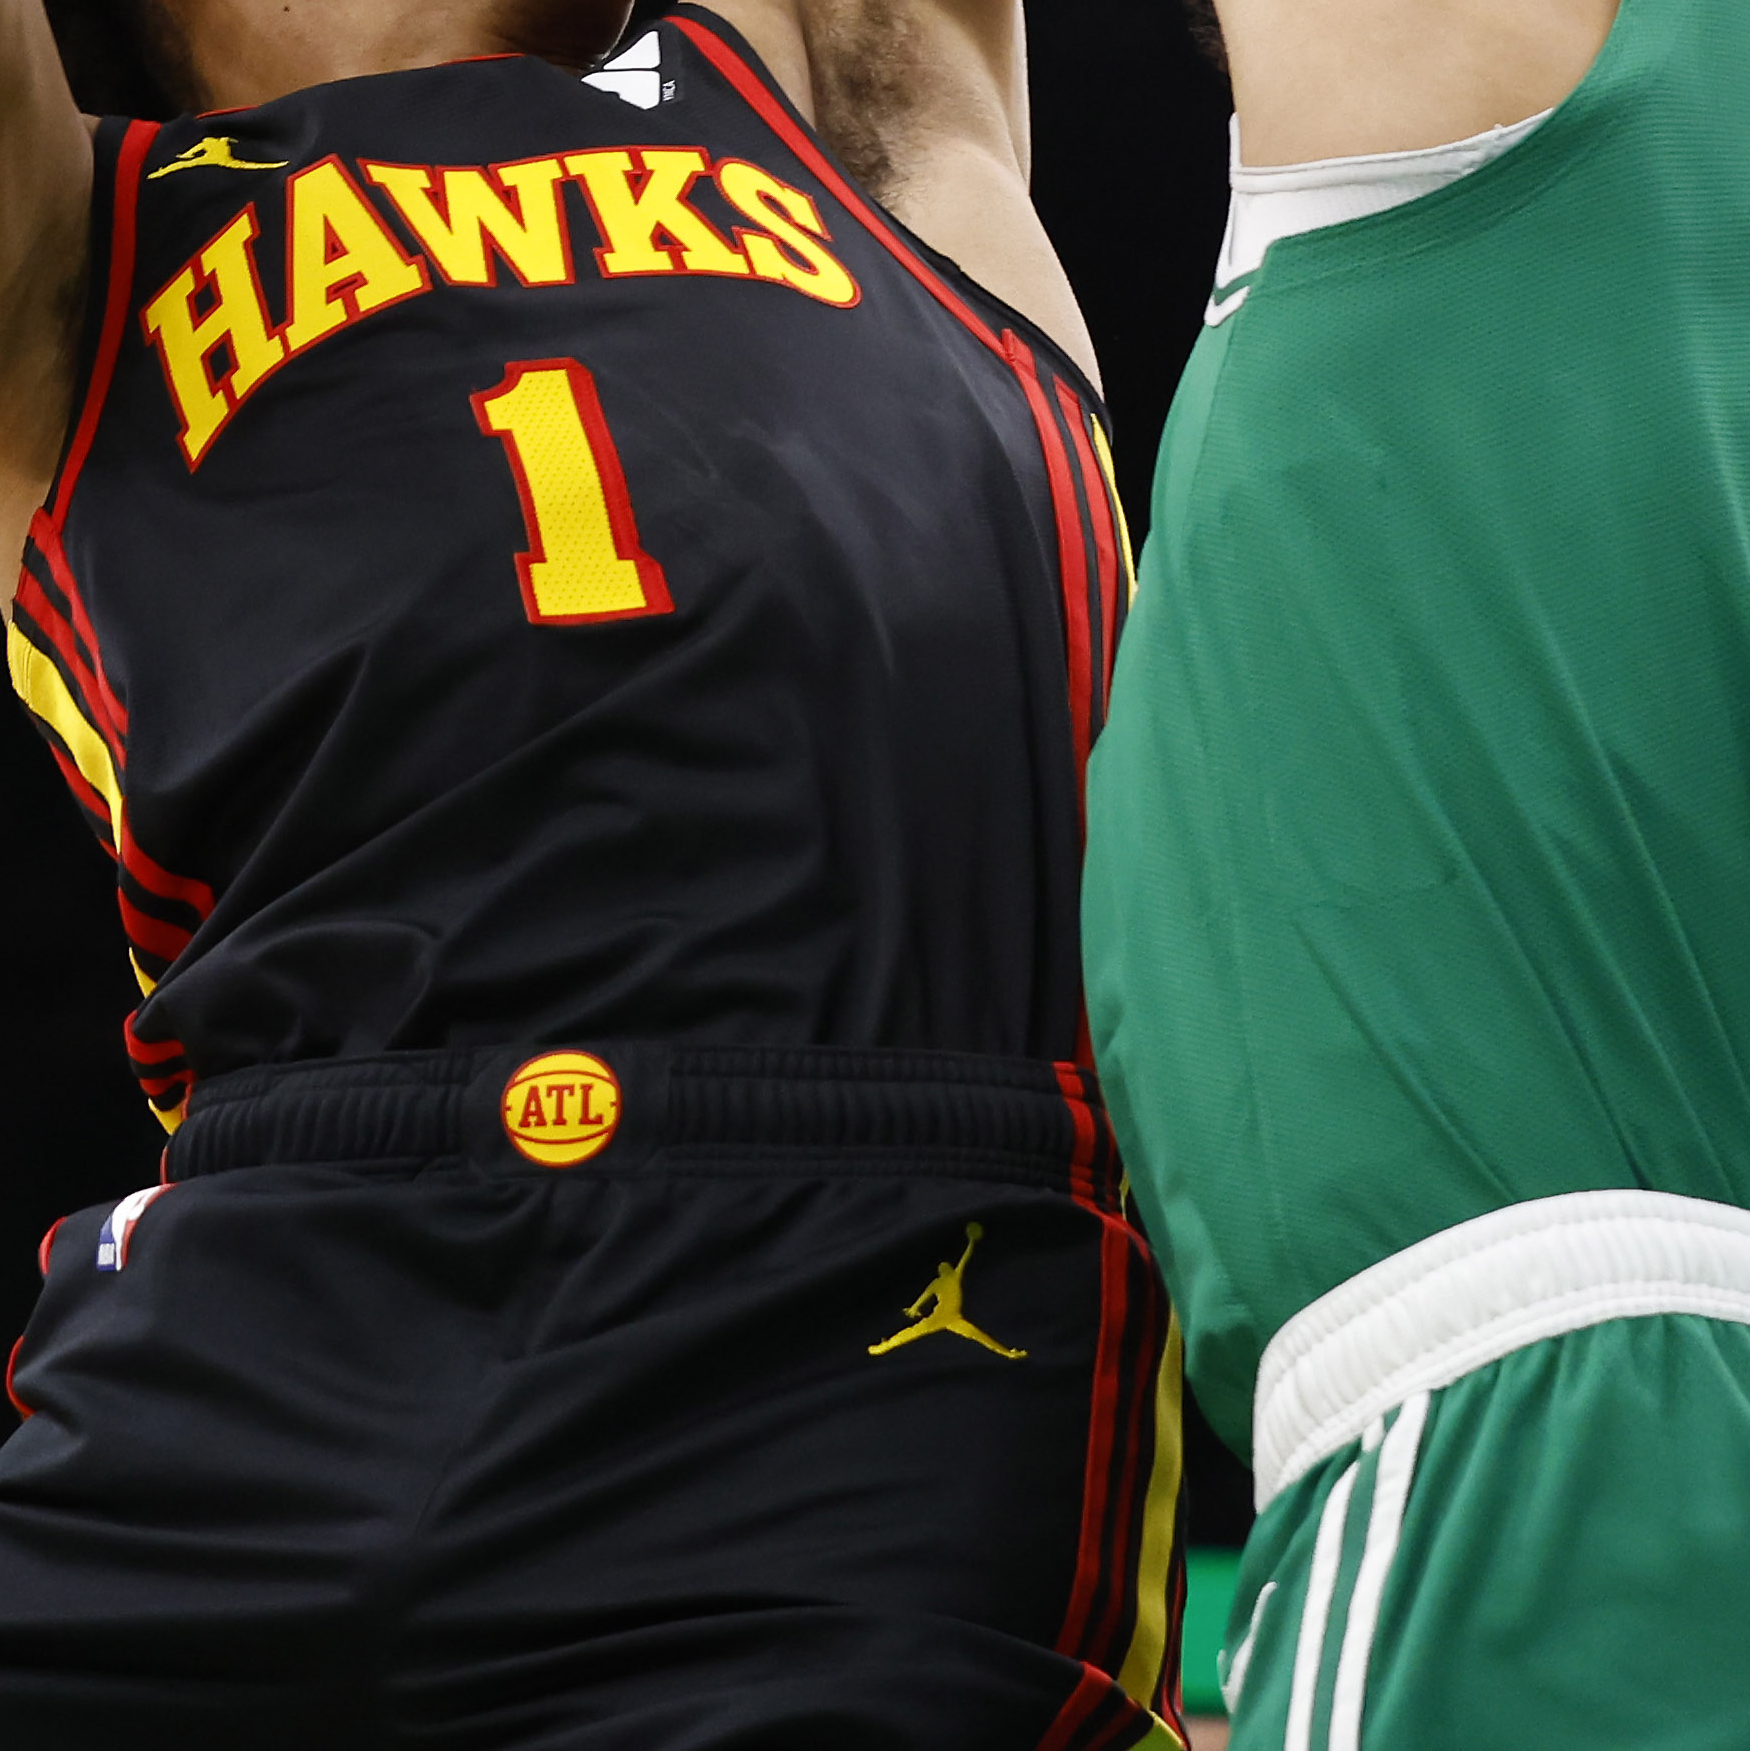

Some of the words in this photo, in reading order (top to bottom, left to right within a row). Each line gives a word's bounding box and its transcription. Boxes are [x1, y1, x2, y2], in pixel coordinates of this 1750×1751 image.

[139, 144, 862, 473] HAWKS
[469, 356, 676, 625] 1
[518, 1082, 604, 1128] ATL
